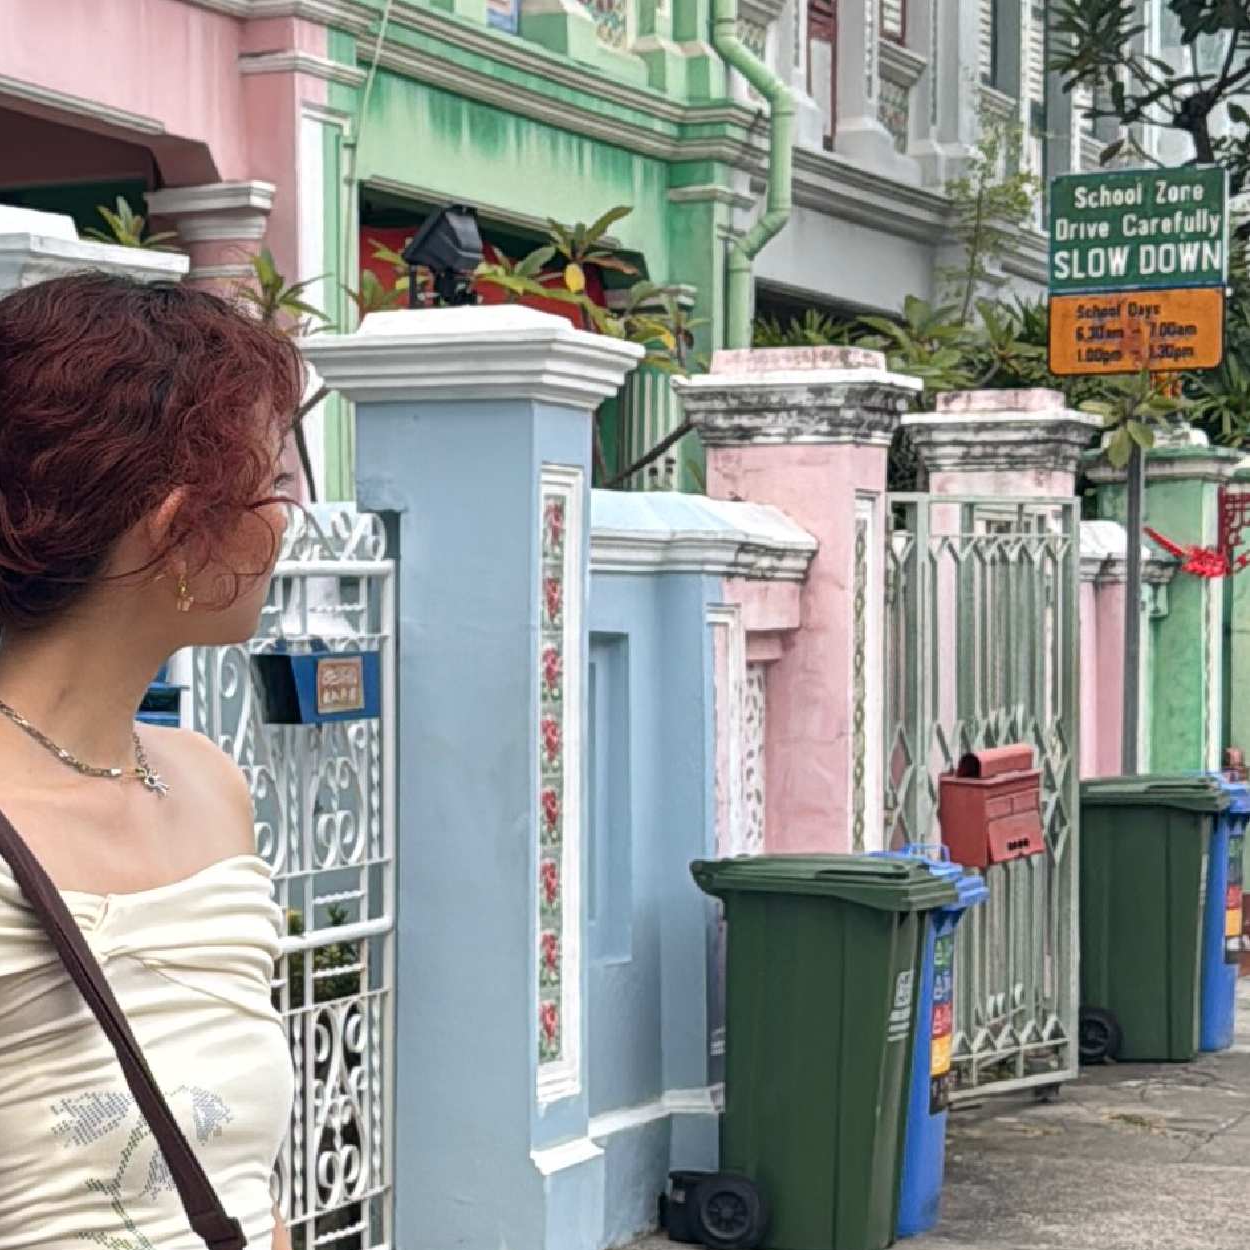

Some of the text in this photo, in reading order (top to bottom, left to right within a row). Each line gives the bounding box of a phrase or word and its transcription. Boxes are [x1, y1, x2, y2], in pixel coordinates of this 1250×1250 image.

[1074, 182, 1142, 209] School
[1055, 208, 1222, 241] Drive Carefully
[1054, 240, 1222, 279] SLOW DOWN
